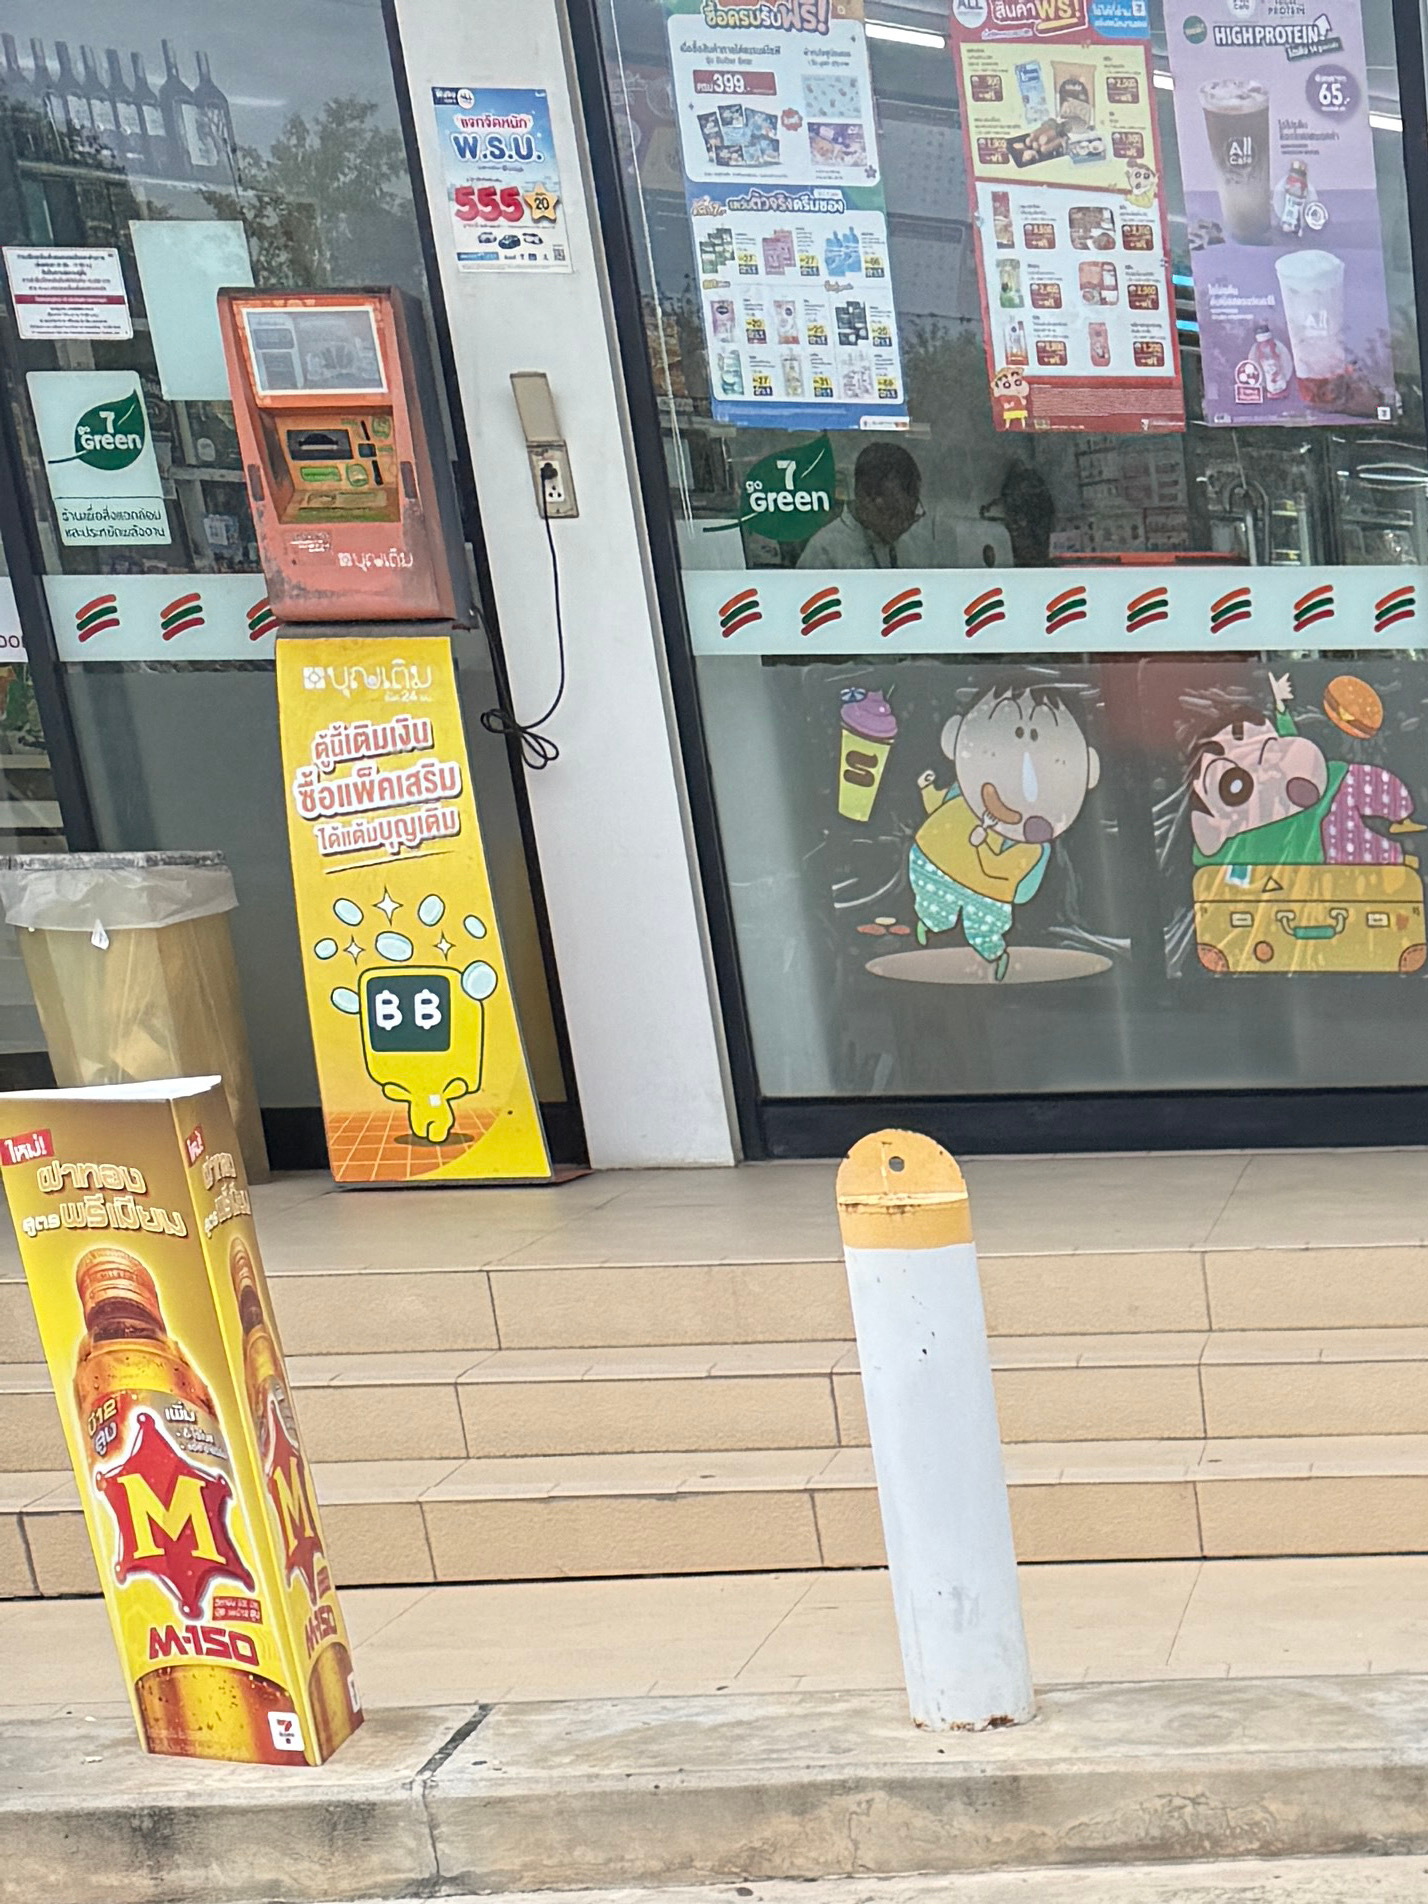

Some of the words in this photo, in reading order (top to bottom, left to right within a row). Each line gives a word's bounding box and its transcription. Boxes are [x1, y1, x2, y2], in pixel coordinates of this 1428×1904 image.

[453, 135, 543, 160] พ.ร.บ.
[455, 186, 524, 222] 555
[534, 197, 550, 211] 20
[99, 411, 115, 434] 7
[81, 433, 142, 450] Green
[745, 480, 763, 493] go
[776, 460, 796, 490] 7
[749, 490, 830, 513] Green
[326, 658, 432, 698] บุญเติม
[299, 762, 456, 813] ซื้อแพ็คเสริม
[317, 807, 456, 849] ได้แต้มบุญเติม
[4, 1133, 47, 1163] ใหม่!
[117, 1473, 227, 1565] M
[273, 1456, 315, 1556] M
[149, 1624, 260, 1667] M-150
